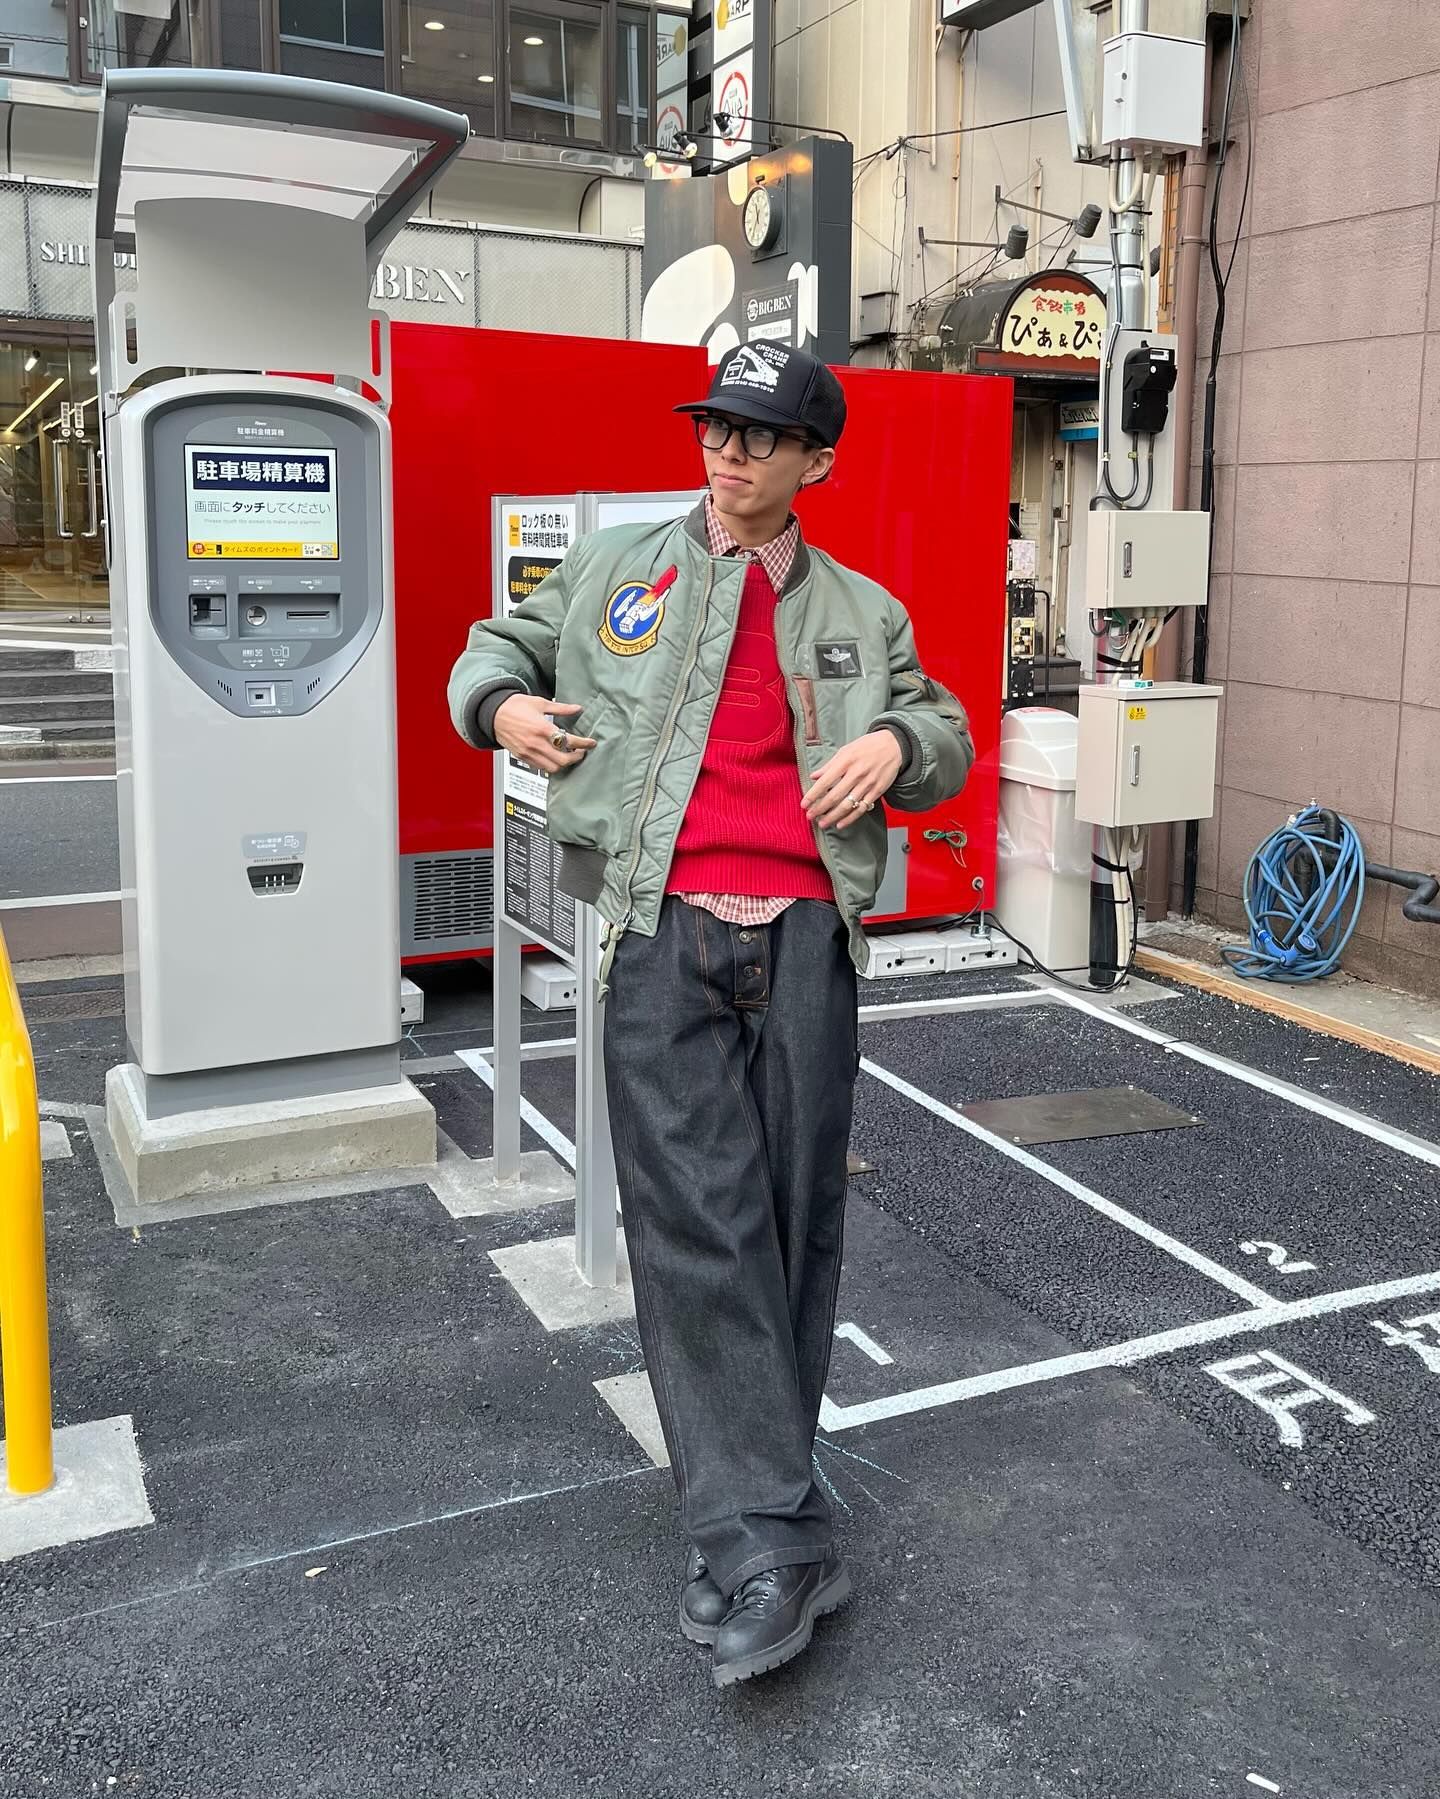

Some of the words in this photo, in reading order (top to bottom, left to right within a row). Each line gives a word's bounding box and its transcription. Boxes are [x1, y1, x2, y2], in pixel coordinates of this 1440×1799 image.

[374, 264, 470, 305] BEN
[755, 343, 790, 360] CROCKER
[763, 351, 788, 364] CRANE
[196, 459, 326, 484] 駐車場精算機
[194, 501, 331, 514] 画面にタッチしてください
[521, 513, 569, 529] ロック板の無い
[1239, 1240, 1316, 1274] 2
[834, 1322, 894, 1366] 1
